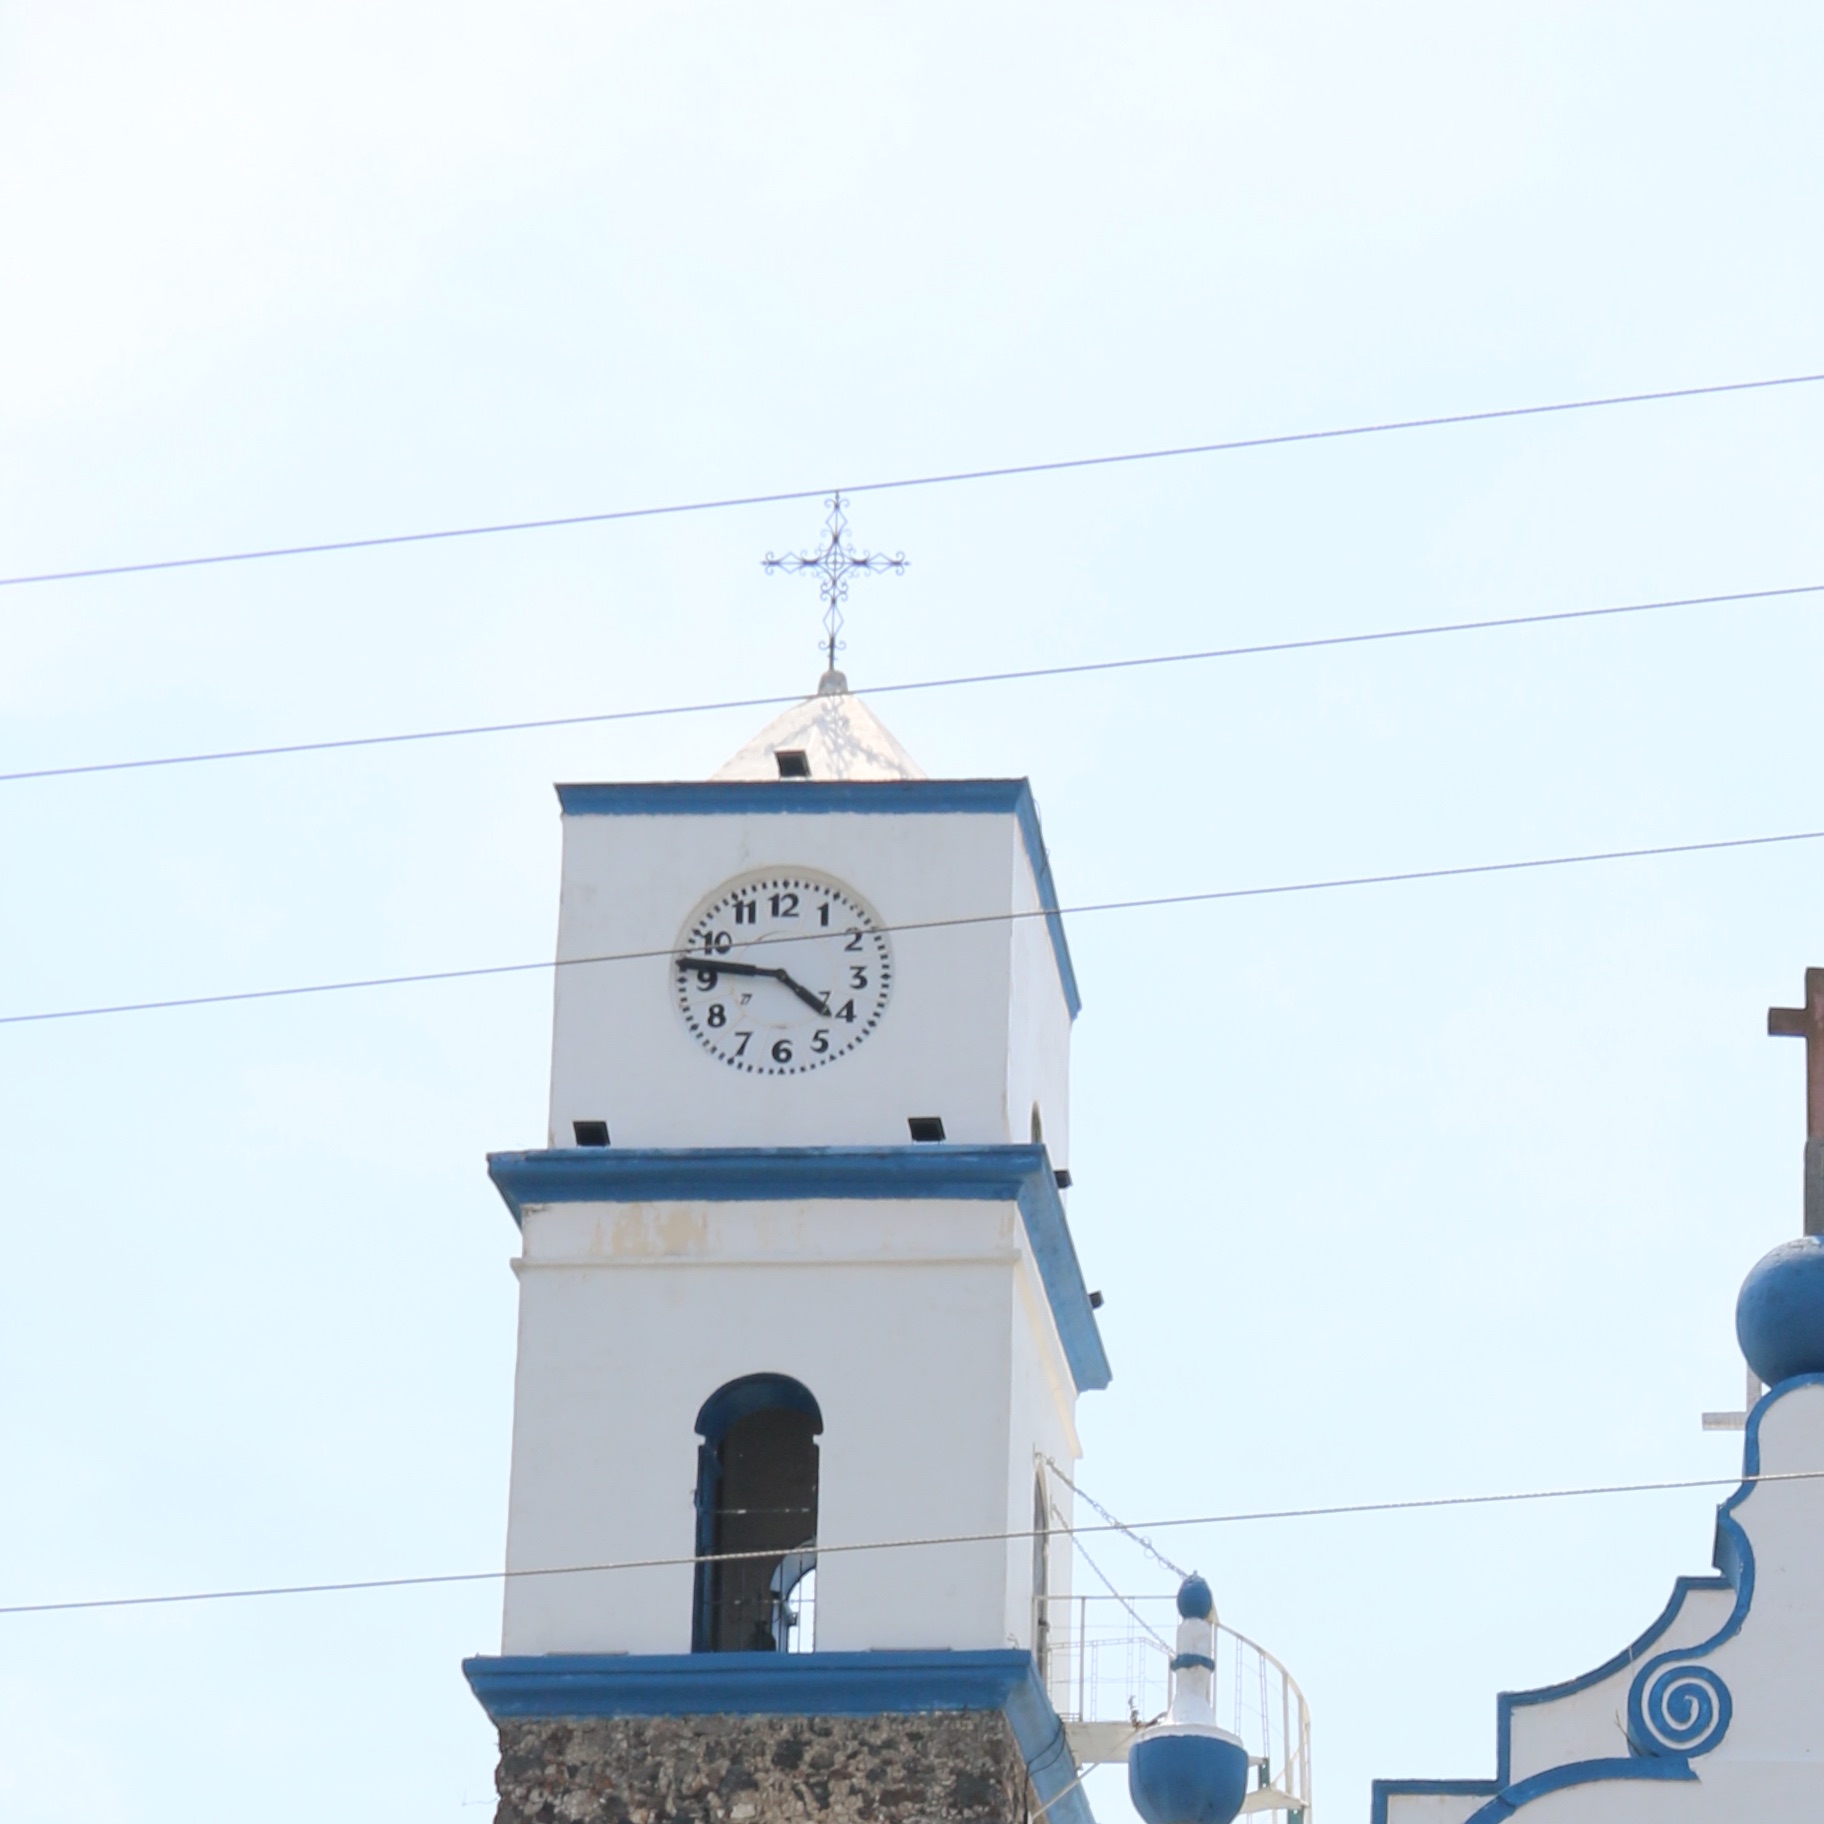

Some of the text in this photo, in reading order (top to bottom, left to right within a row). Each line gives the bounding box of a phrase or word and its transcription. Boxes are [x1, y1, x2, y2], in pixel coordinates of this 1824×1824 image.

[732, 900, 757, 925] 11
[768, 892, 800, 918] 12
[817, 902, 829, 927] 1
[700, 931, 732, 955] 10
[844, 928, 864, 952] 2
[696, 968, 718, 992] 9
[849, 966, 869, 990] 3
[707, 1003, 727, 1028] 8
[835, 998, 857, 1023] 4
[734, 1031, 754, 1057] 7
[771, 1039, 793, 1064] 6
[810, 1029, 830, 1053] 5
